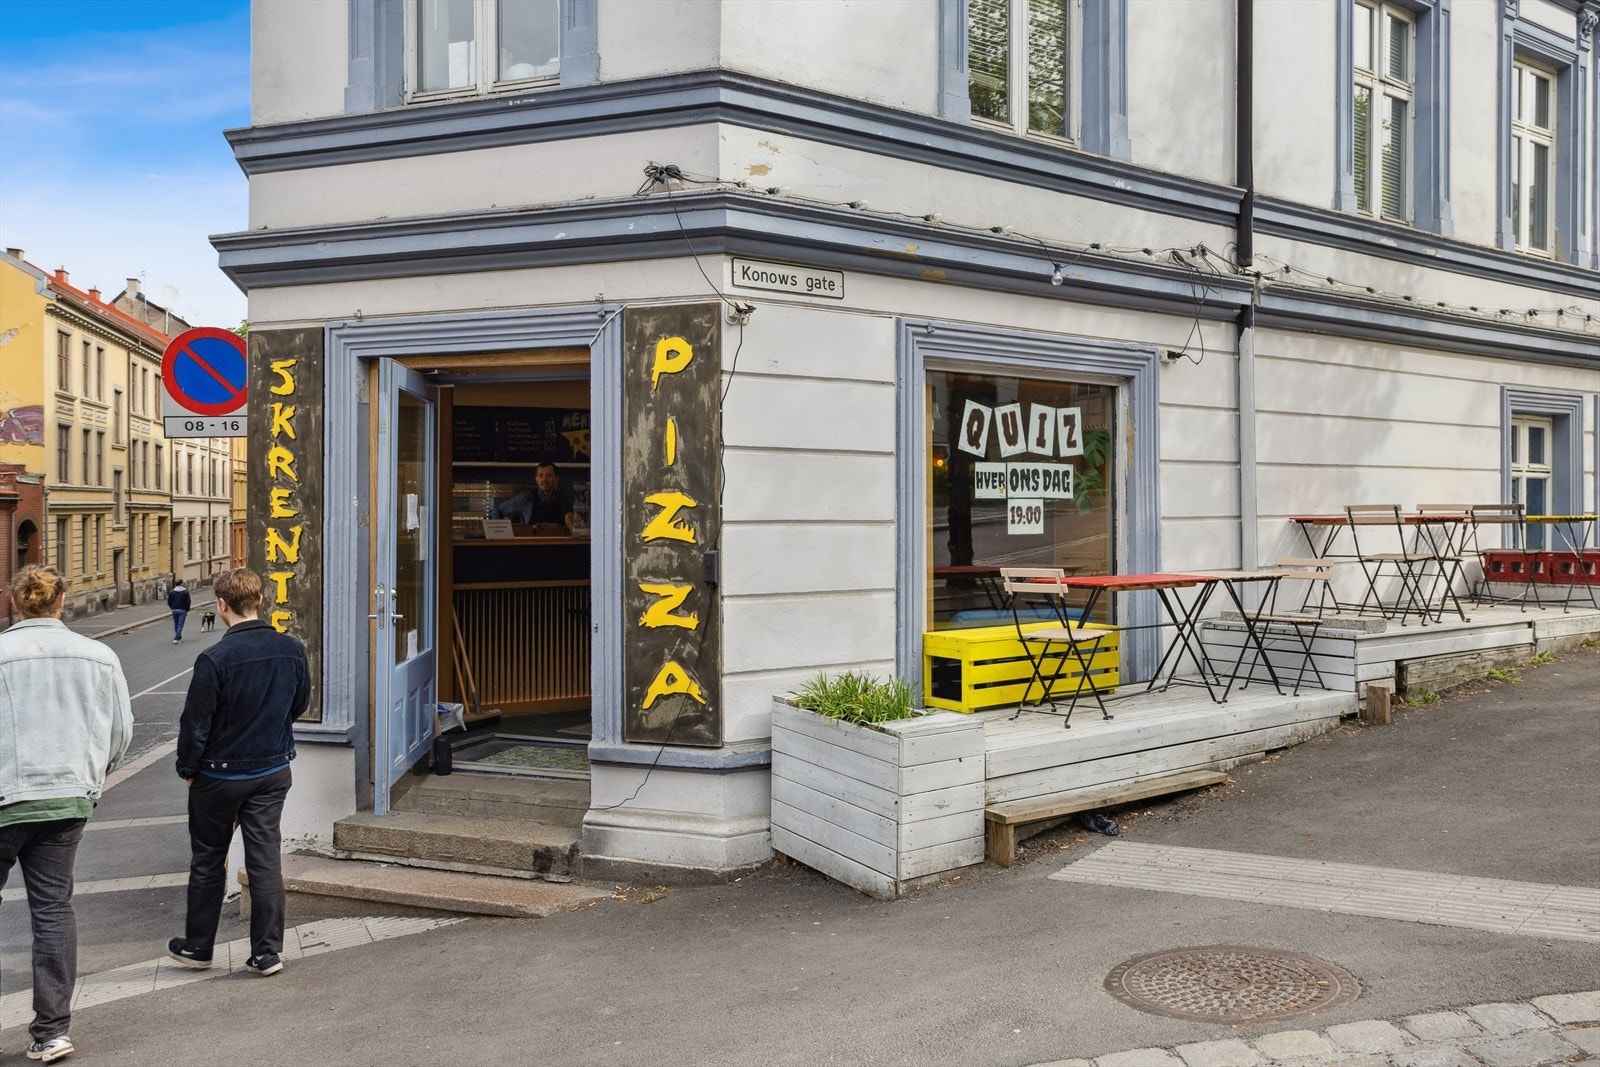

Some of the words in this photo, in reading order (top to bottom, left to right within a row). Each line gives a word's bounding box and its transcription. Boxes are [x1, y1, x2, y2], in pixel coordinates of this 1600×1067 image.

[742, 265, 798, 286] Konows
[805, 276, 836, 292] gate
[184, 421, 205, 431] 08
[221, 421, 240, 431] 16
[966, 408, 1078, 450] QUIZ
[976, 471, 1006, 490] HVER
[638, 336, 707, 710] PIZZA
[1009, 505, 1042, 525] 19:00
